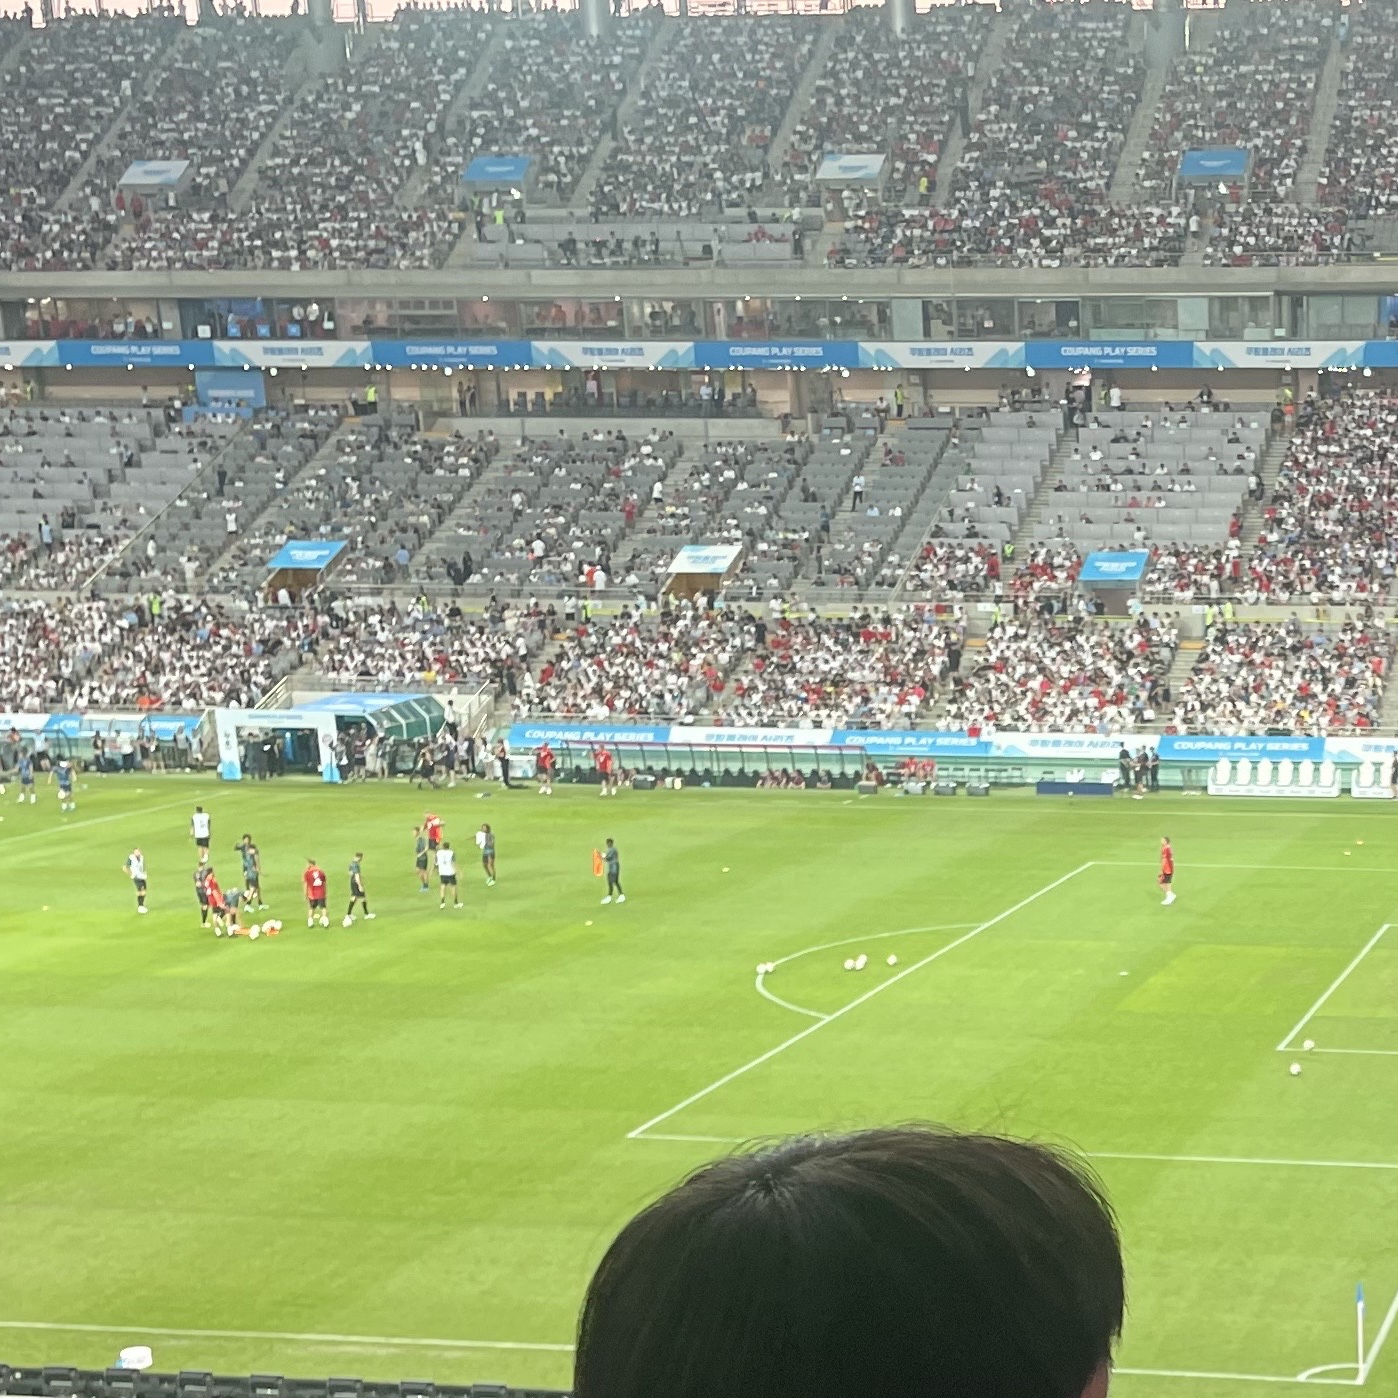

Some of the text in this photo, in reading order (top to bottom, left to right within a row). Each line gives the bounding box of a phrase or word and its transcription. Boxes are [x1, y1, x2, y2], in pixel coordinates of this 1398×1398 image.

[1104, 347, 1125, 356] PLAY
[525, 729, 654, 742] COUPANG PLAY SERIES
[845, 735, 978, 747] COUPANG PLAY SERIES
[1174, 741, 1309, 751] COUPANG PLAY SERIES
